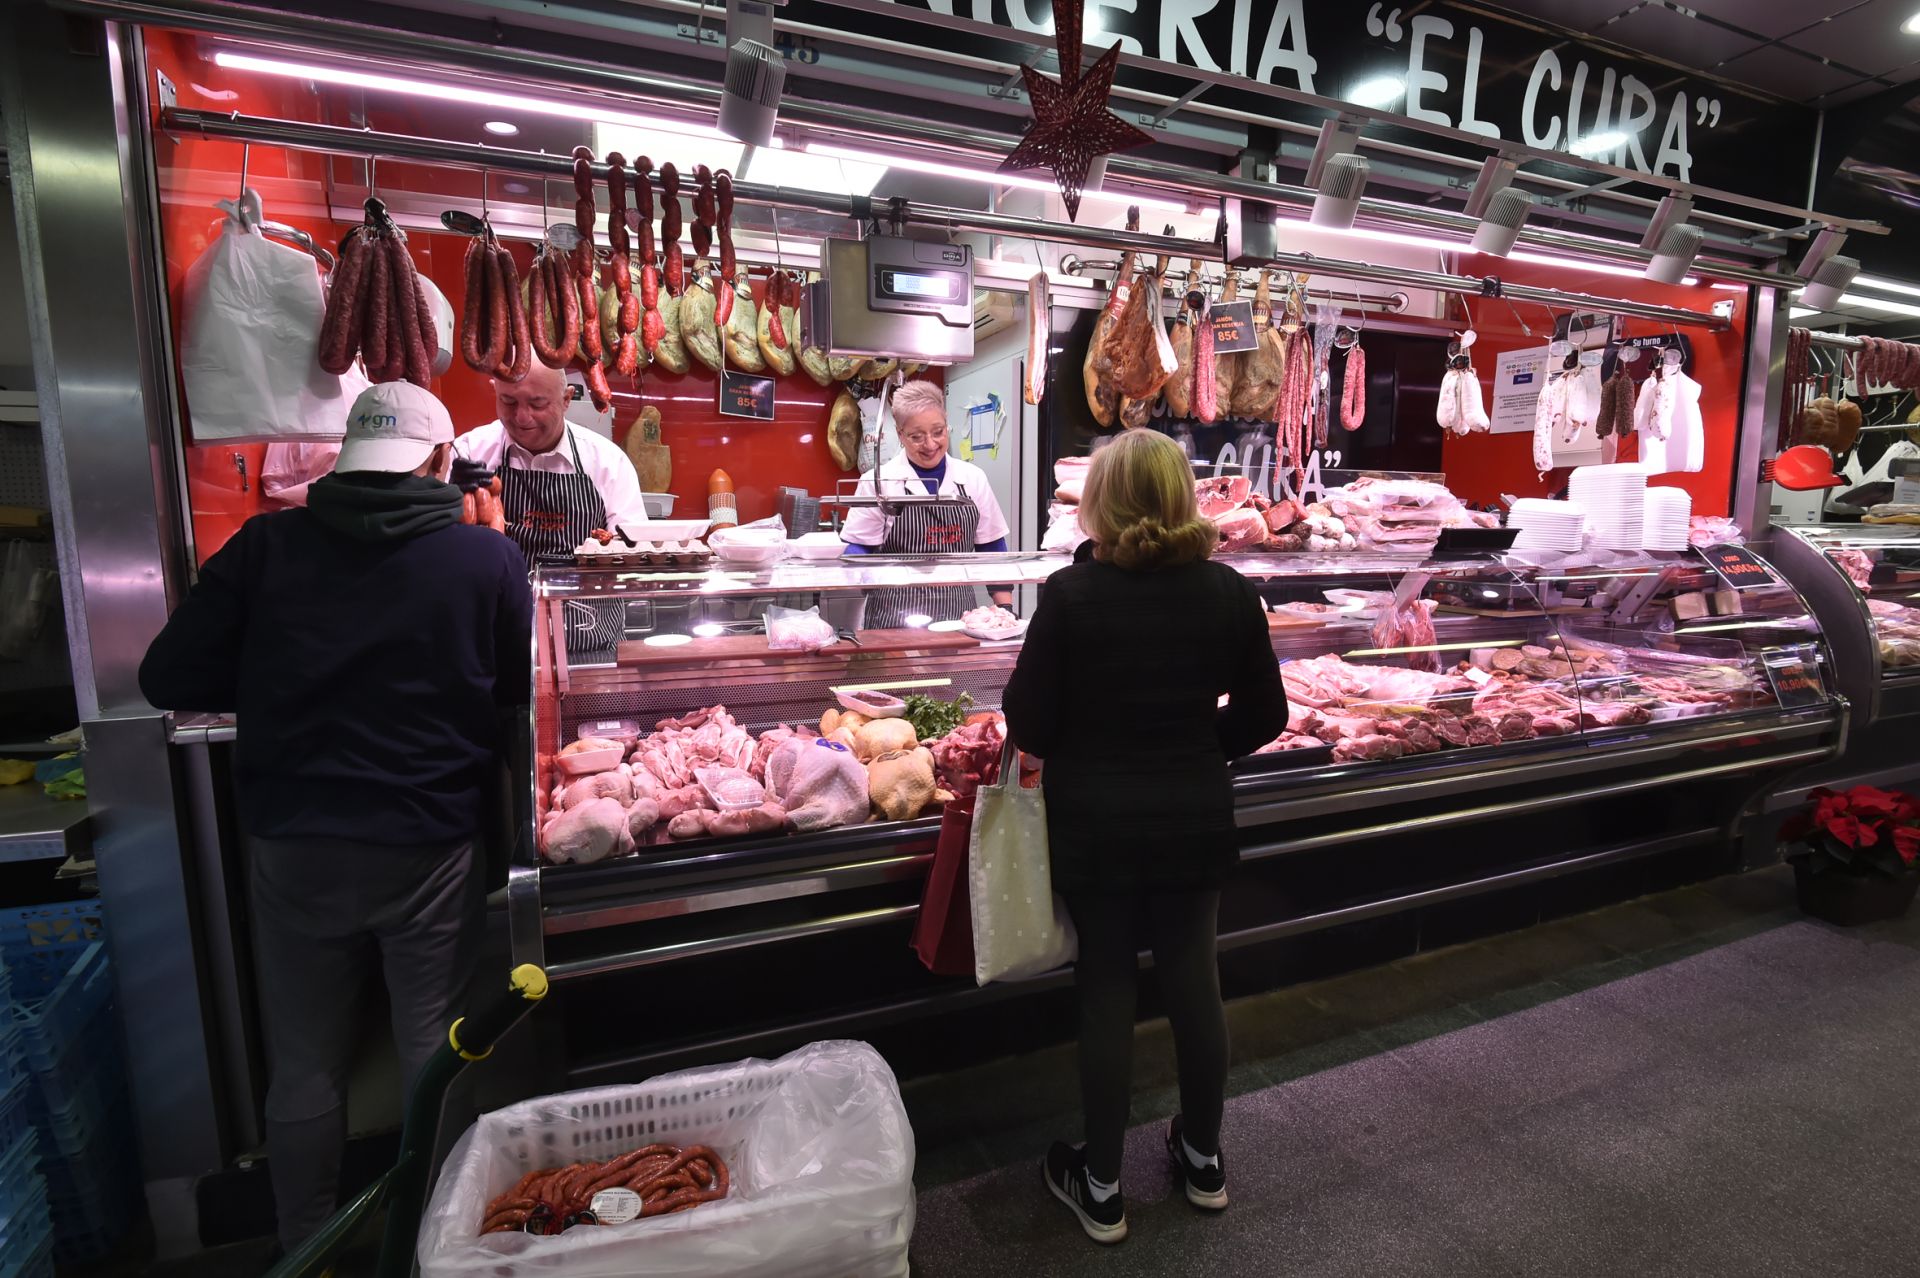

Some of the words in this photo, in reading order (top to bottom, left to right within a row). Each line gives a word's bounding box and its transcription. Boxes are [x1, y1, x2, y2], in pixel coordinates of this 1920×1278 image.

[880, 0, 1317, 95] ERIA
[1217, 329, 1239, 341] 85€
[1632, 338, 1642, 347] Su
[1642, 336, 1661, 346] turno
[737, 396, 758, 408] 85€
